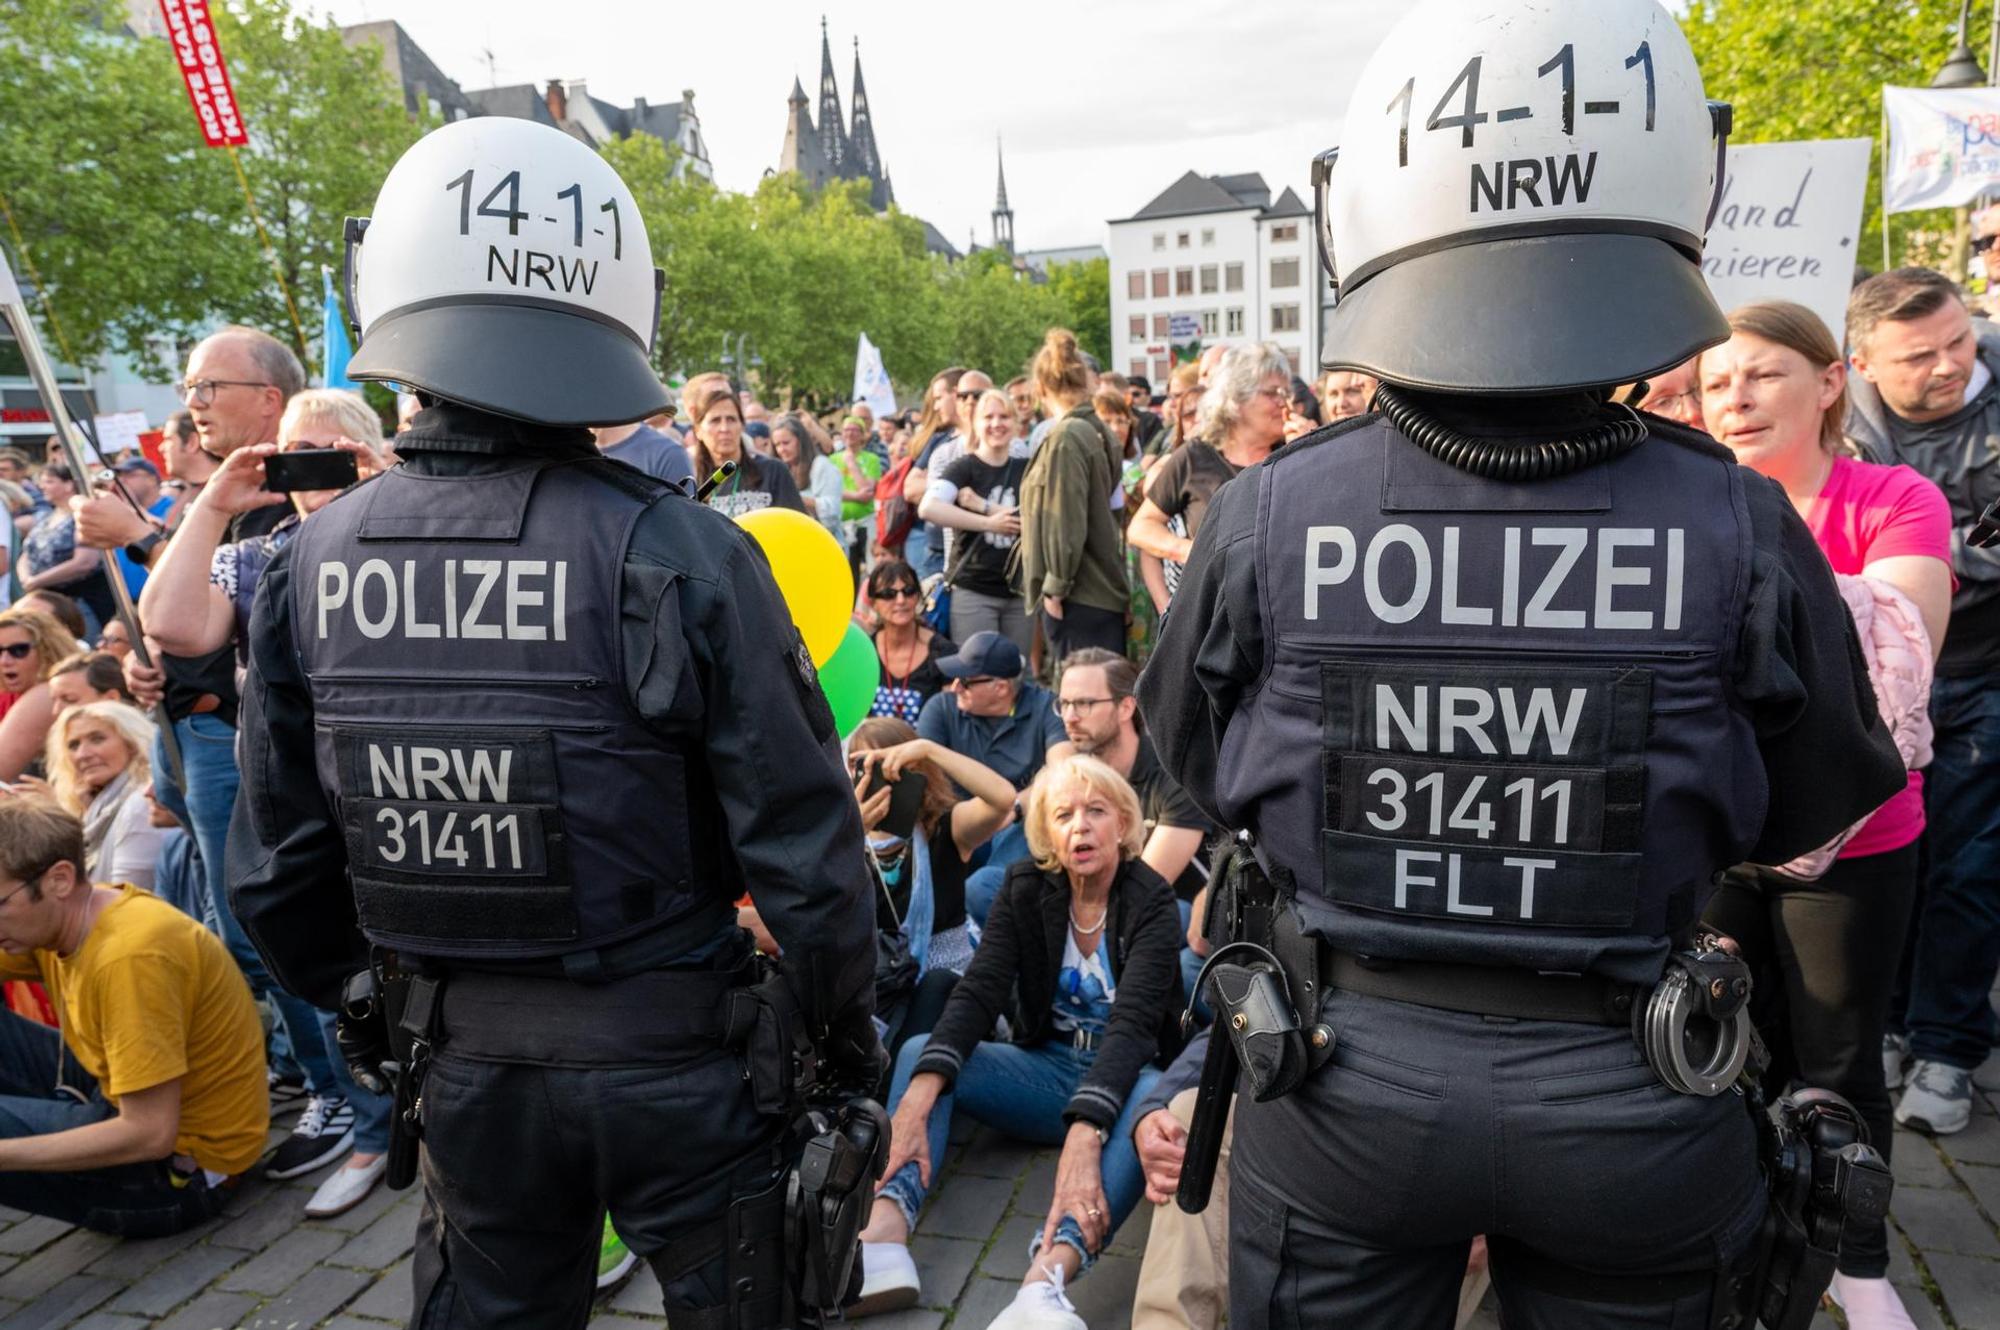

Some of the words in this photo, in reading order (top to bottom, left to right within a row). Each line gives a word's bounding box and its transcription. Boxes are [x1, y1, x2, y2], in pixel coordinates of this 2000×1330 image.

[183, 0, 242, 138] KRIEGST
[1386, 41, 1656, 168] 14-1-1
[187, 72, 223, 140] ROTE
[446, 169, 622, 261] 14-1-1
[1470, 151, 1598, 213] NRW
[487, 245, 598, 295] NRW
[317, 558, 568, 641] POLIZEI
[1304, 523, 1685, 630] POLIZEI
[1375, 684, 1588, 756] NRW
[368, 744, 513, 803] NRW
[1365, 767, 1572, 844] 31411
[376, 807, 522, 869] 31411
[1394, 849, 1556, 919] FLT
